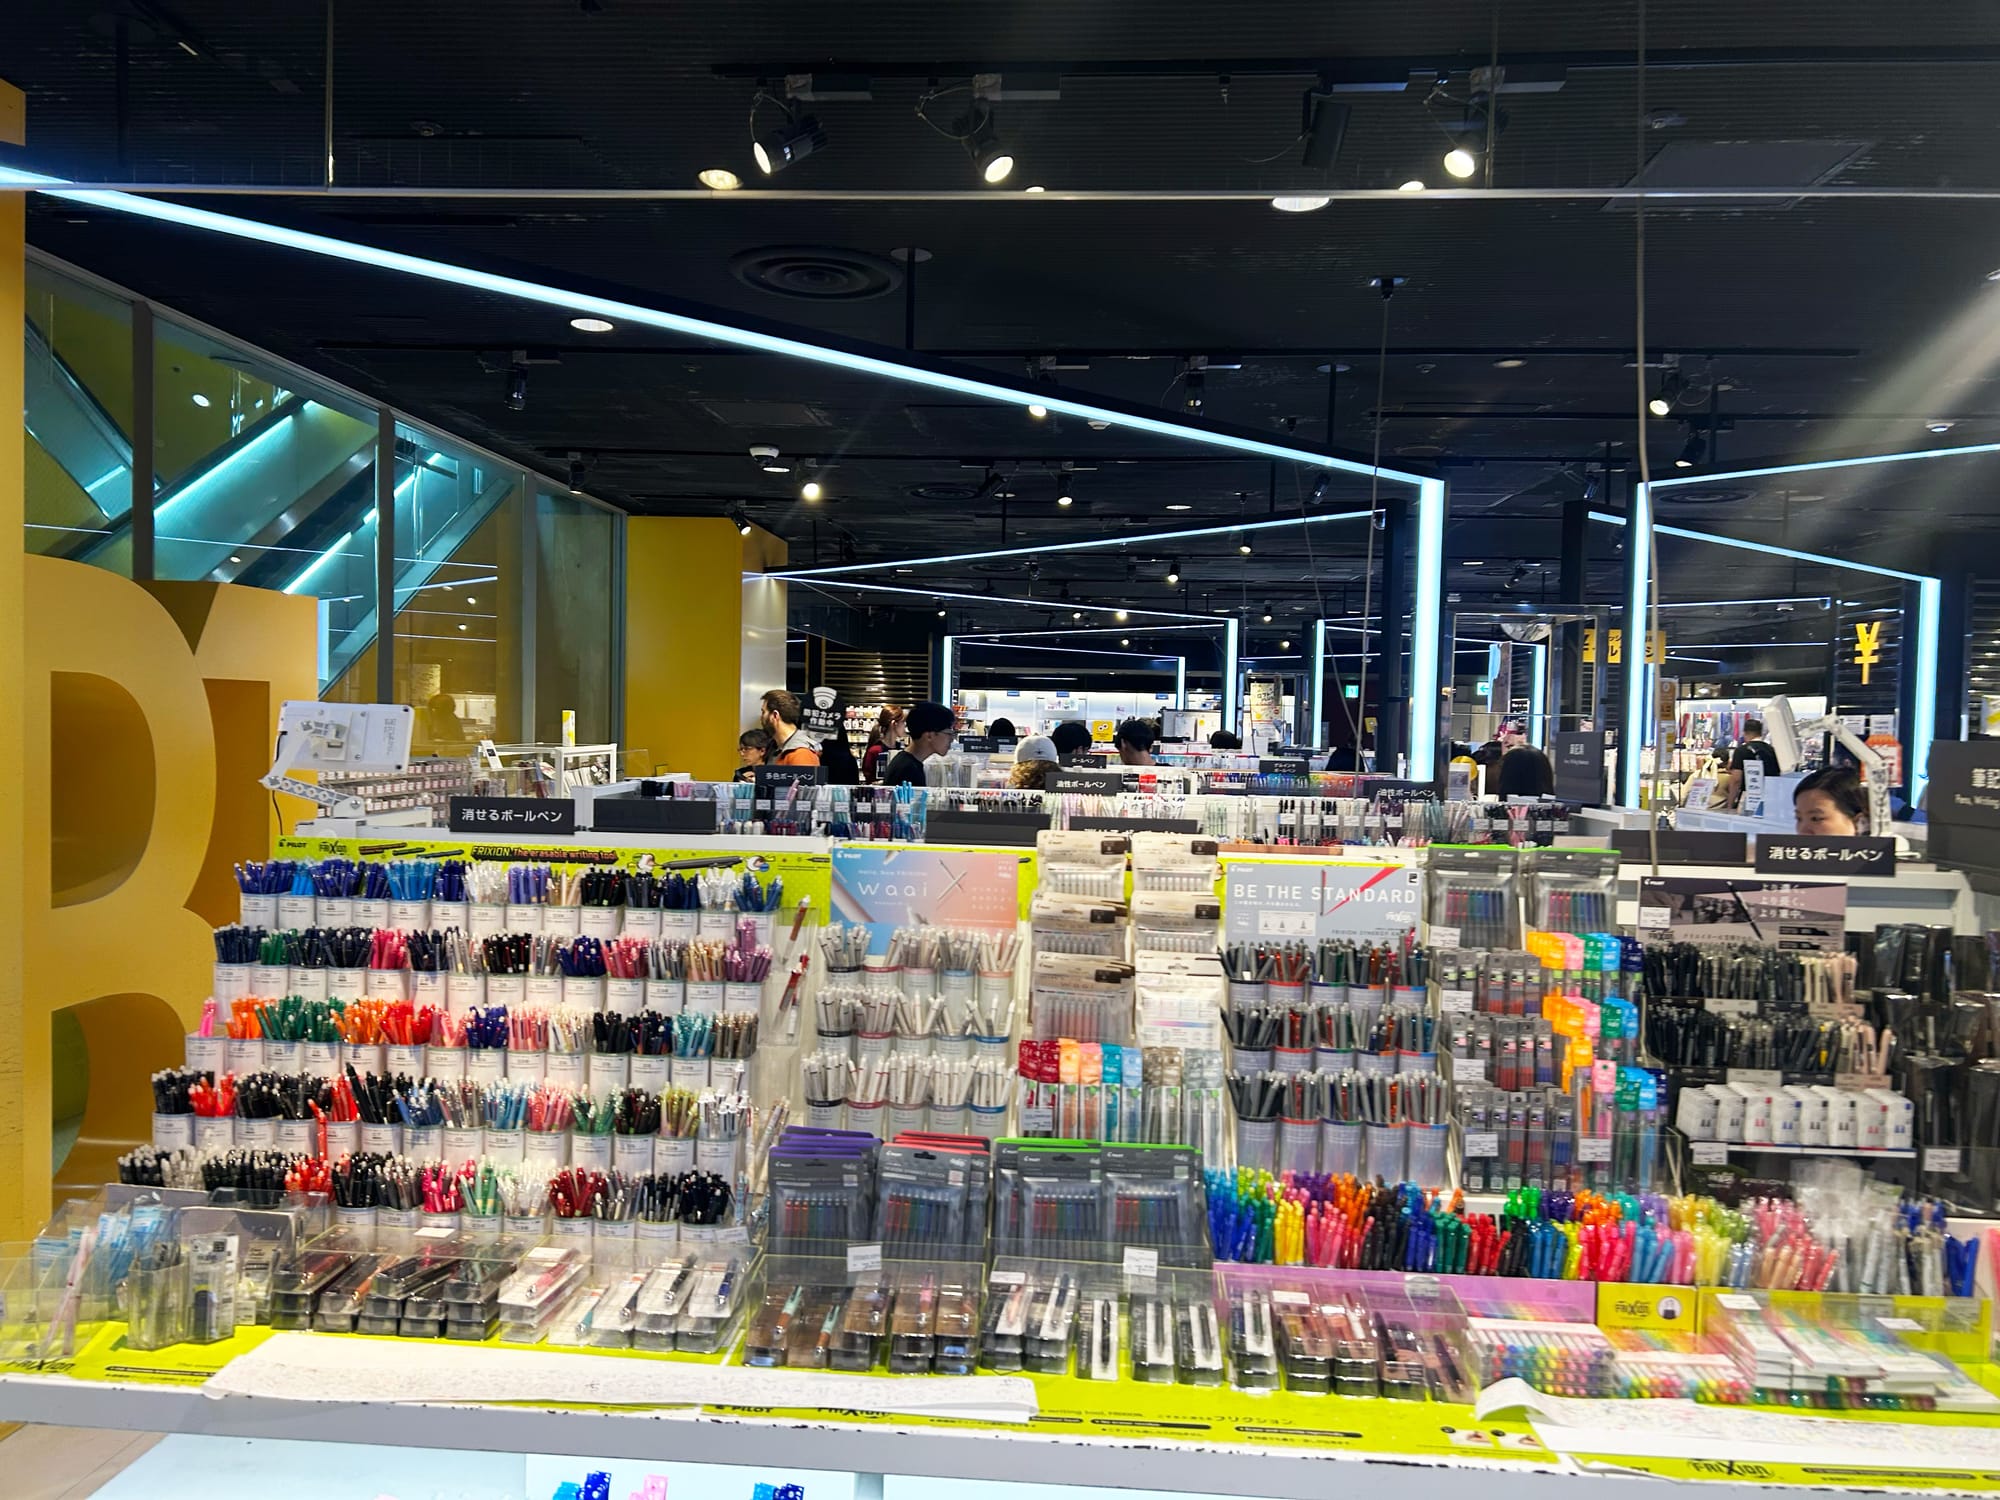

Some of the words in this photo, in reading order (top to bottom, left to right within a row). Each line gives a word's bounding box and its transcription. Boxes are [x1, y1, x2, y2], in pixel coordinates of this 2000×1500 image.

[803, 708, 841, 720] 防犯カメラ
[1055, 780, 1107, 789] 油性ボールペン
[1377, 788, 1435, 798] 油性ボールペン
[461, 808, 562, 822] 消せるボールペン
[1768, 846, 1883, 861] 消せるボールペン
[1234, 883, 1257, 898] BE
[1265, 885, 1302, 900] THE
[1311, 886, 1416, 904] STANDARD
